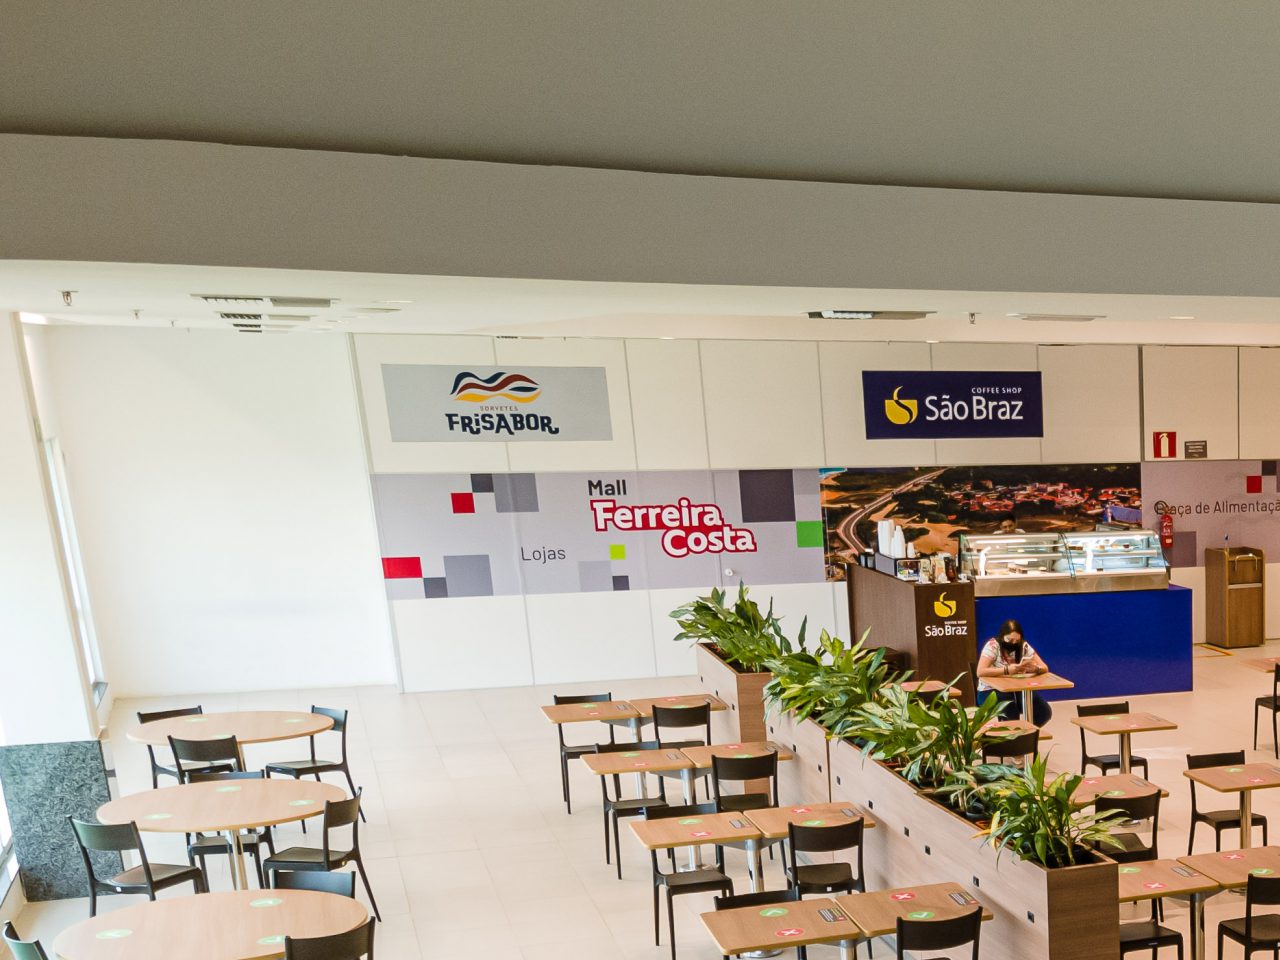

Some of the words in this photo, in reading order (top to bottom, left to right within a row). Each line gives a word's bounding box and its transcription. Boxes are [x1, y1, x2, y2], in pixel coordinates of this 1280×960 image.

[925, 394, 969, 421] São
[972, 395, 1024, 421] Braz
[587, 479, 627, 496] Mall
[592, 498, 723, 530] Ferreira
[1156, 500, 1192, 518] Paça
[1195, 501, 1210, 514] de
[663, 525, 756, 557] Costa
[520, 546, 567, 565] Lojas
[924, 625, 944, 637] São
[944, 625, 968, 636] Braz
